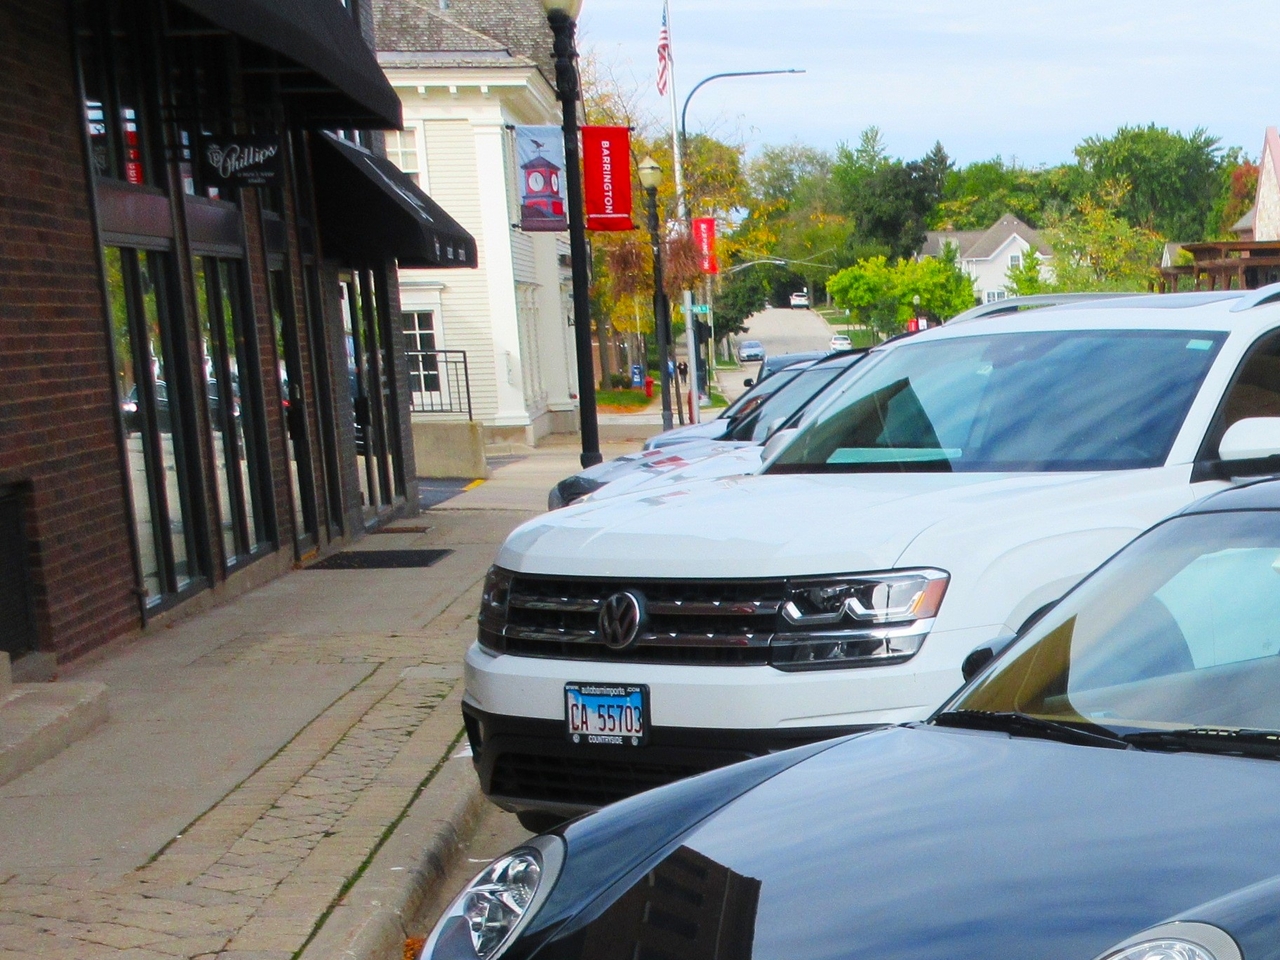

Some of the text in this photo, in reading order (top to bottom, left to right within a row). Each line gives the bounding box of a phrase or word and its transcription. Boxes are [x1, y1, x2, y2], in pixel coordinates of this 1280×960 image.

[220, 144, 278, 178] Phillips
[601, 140, 614, 214] BARRINGTON
[570, 703, 643, 734] CA 55703
